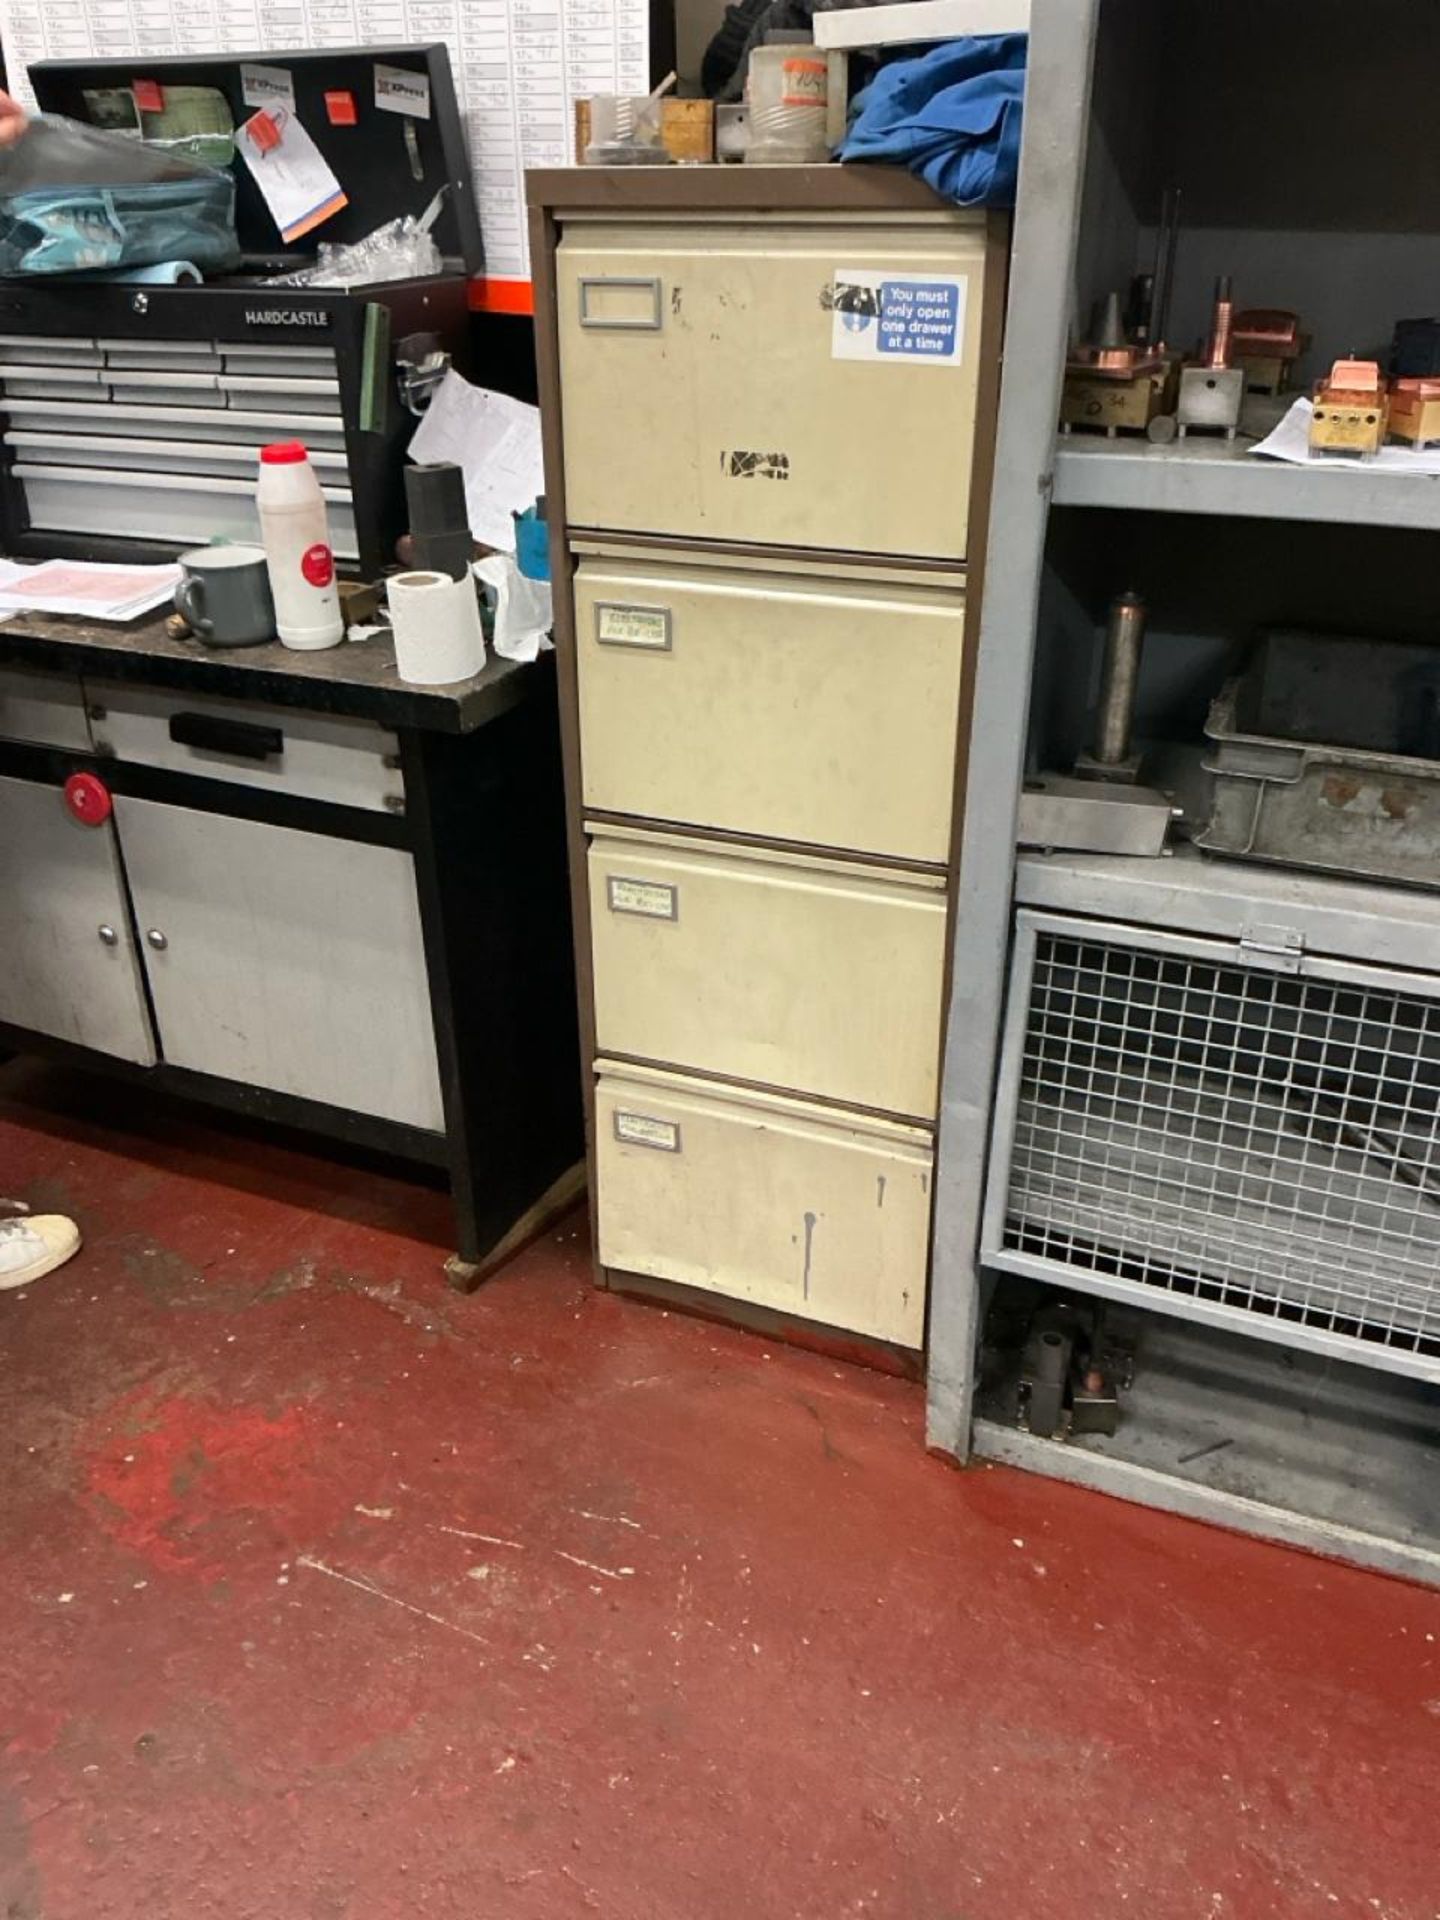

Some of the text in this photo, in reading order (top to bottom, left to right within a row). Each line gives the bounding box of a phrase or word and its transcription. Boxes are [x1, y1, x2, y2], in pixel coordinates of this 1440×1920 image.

[890, 287, 949, 303] You must
[245, 311, 329, 326] HARDCASTLE
[887, 303, 951, 320] only open
[881, 320, 953, 334] one drawer
[888, 336, 944, 351] at a time
